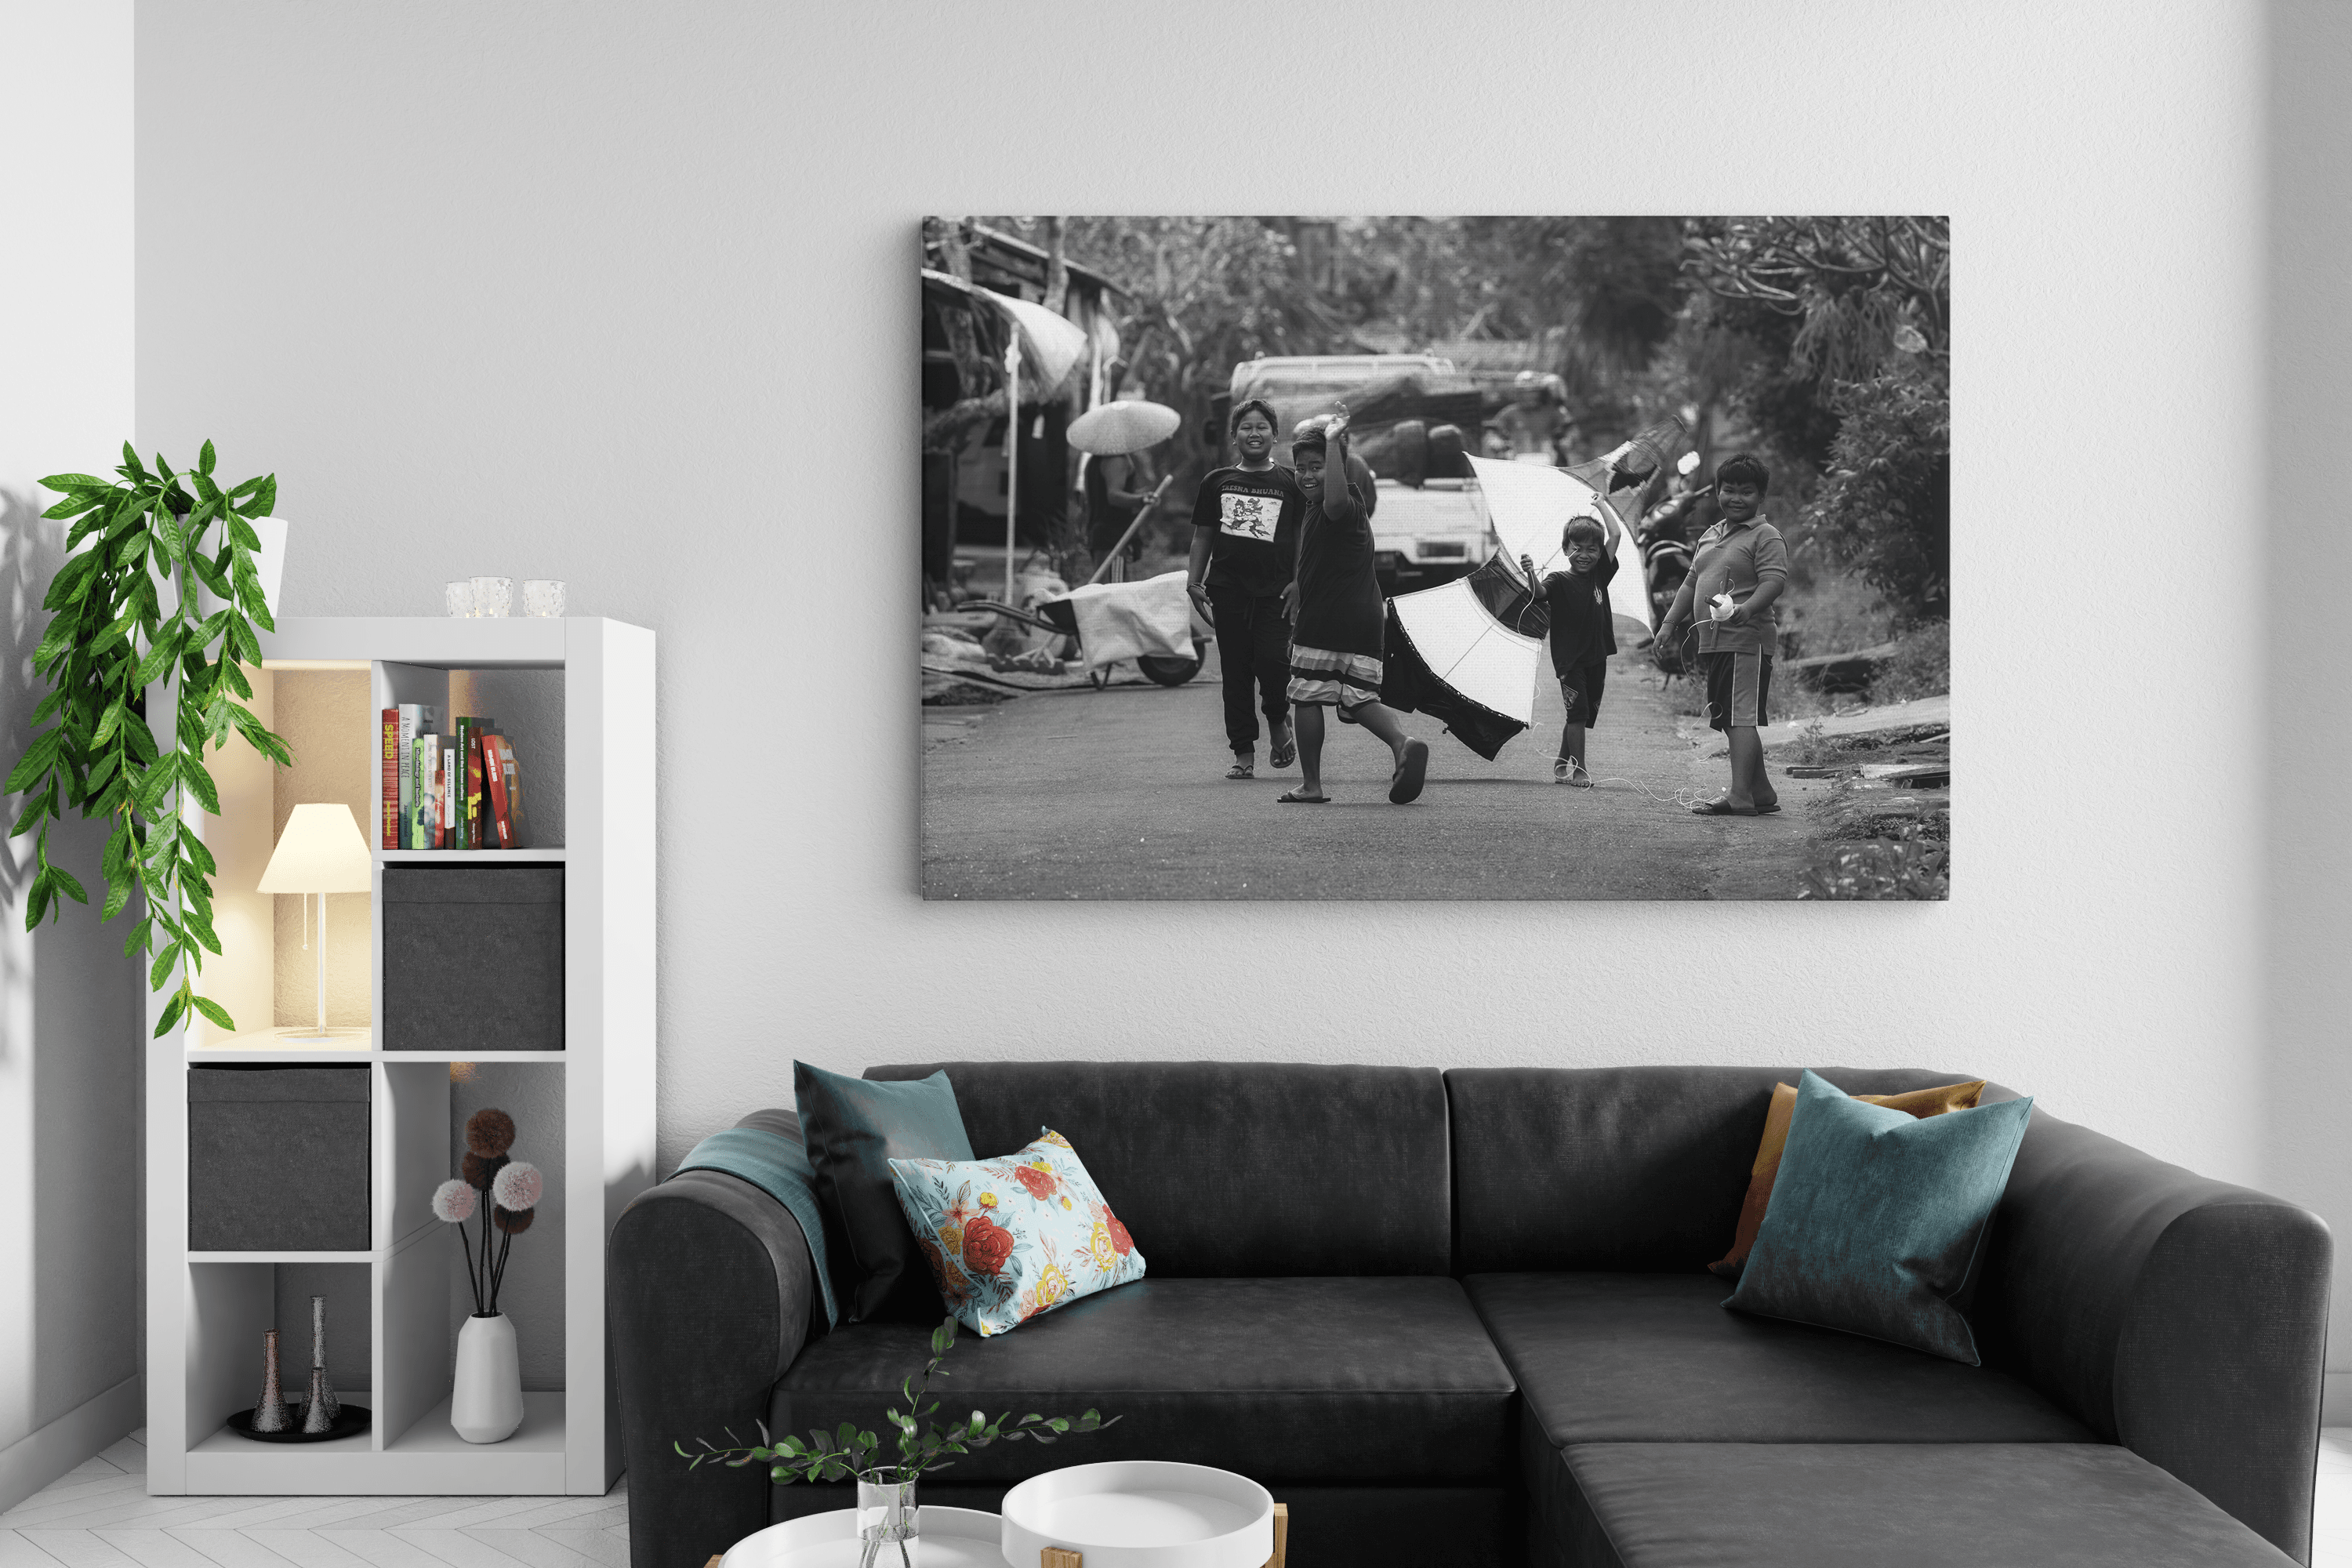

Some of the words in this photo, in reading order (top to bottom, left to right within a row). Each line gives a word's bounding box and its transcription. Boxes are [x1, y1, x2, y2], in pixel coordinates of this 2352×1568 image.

[1250, 488, 1284, 497] BHUANA
[384, 724, 394, 760] SPEED
[401, 723, 410, 750] MOMENT
[401, 752, 410, 760] IN
[401, 762, 410, 779] PEACE
